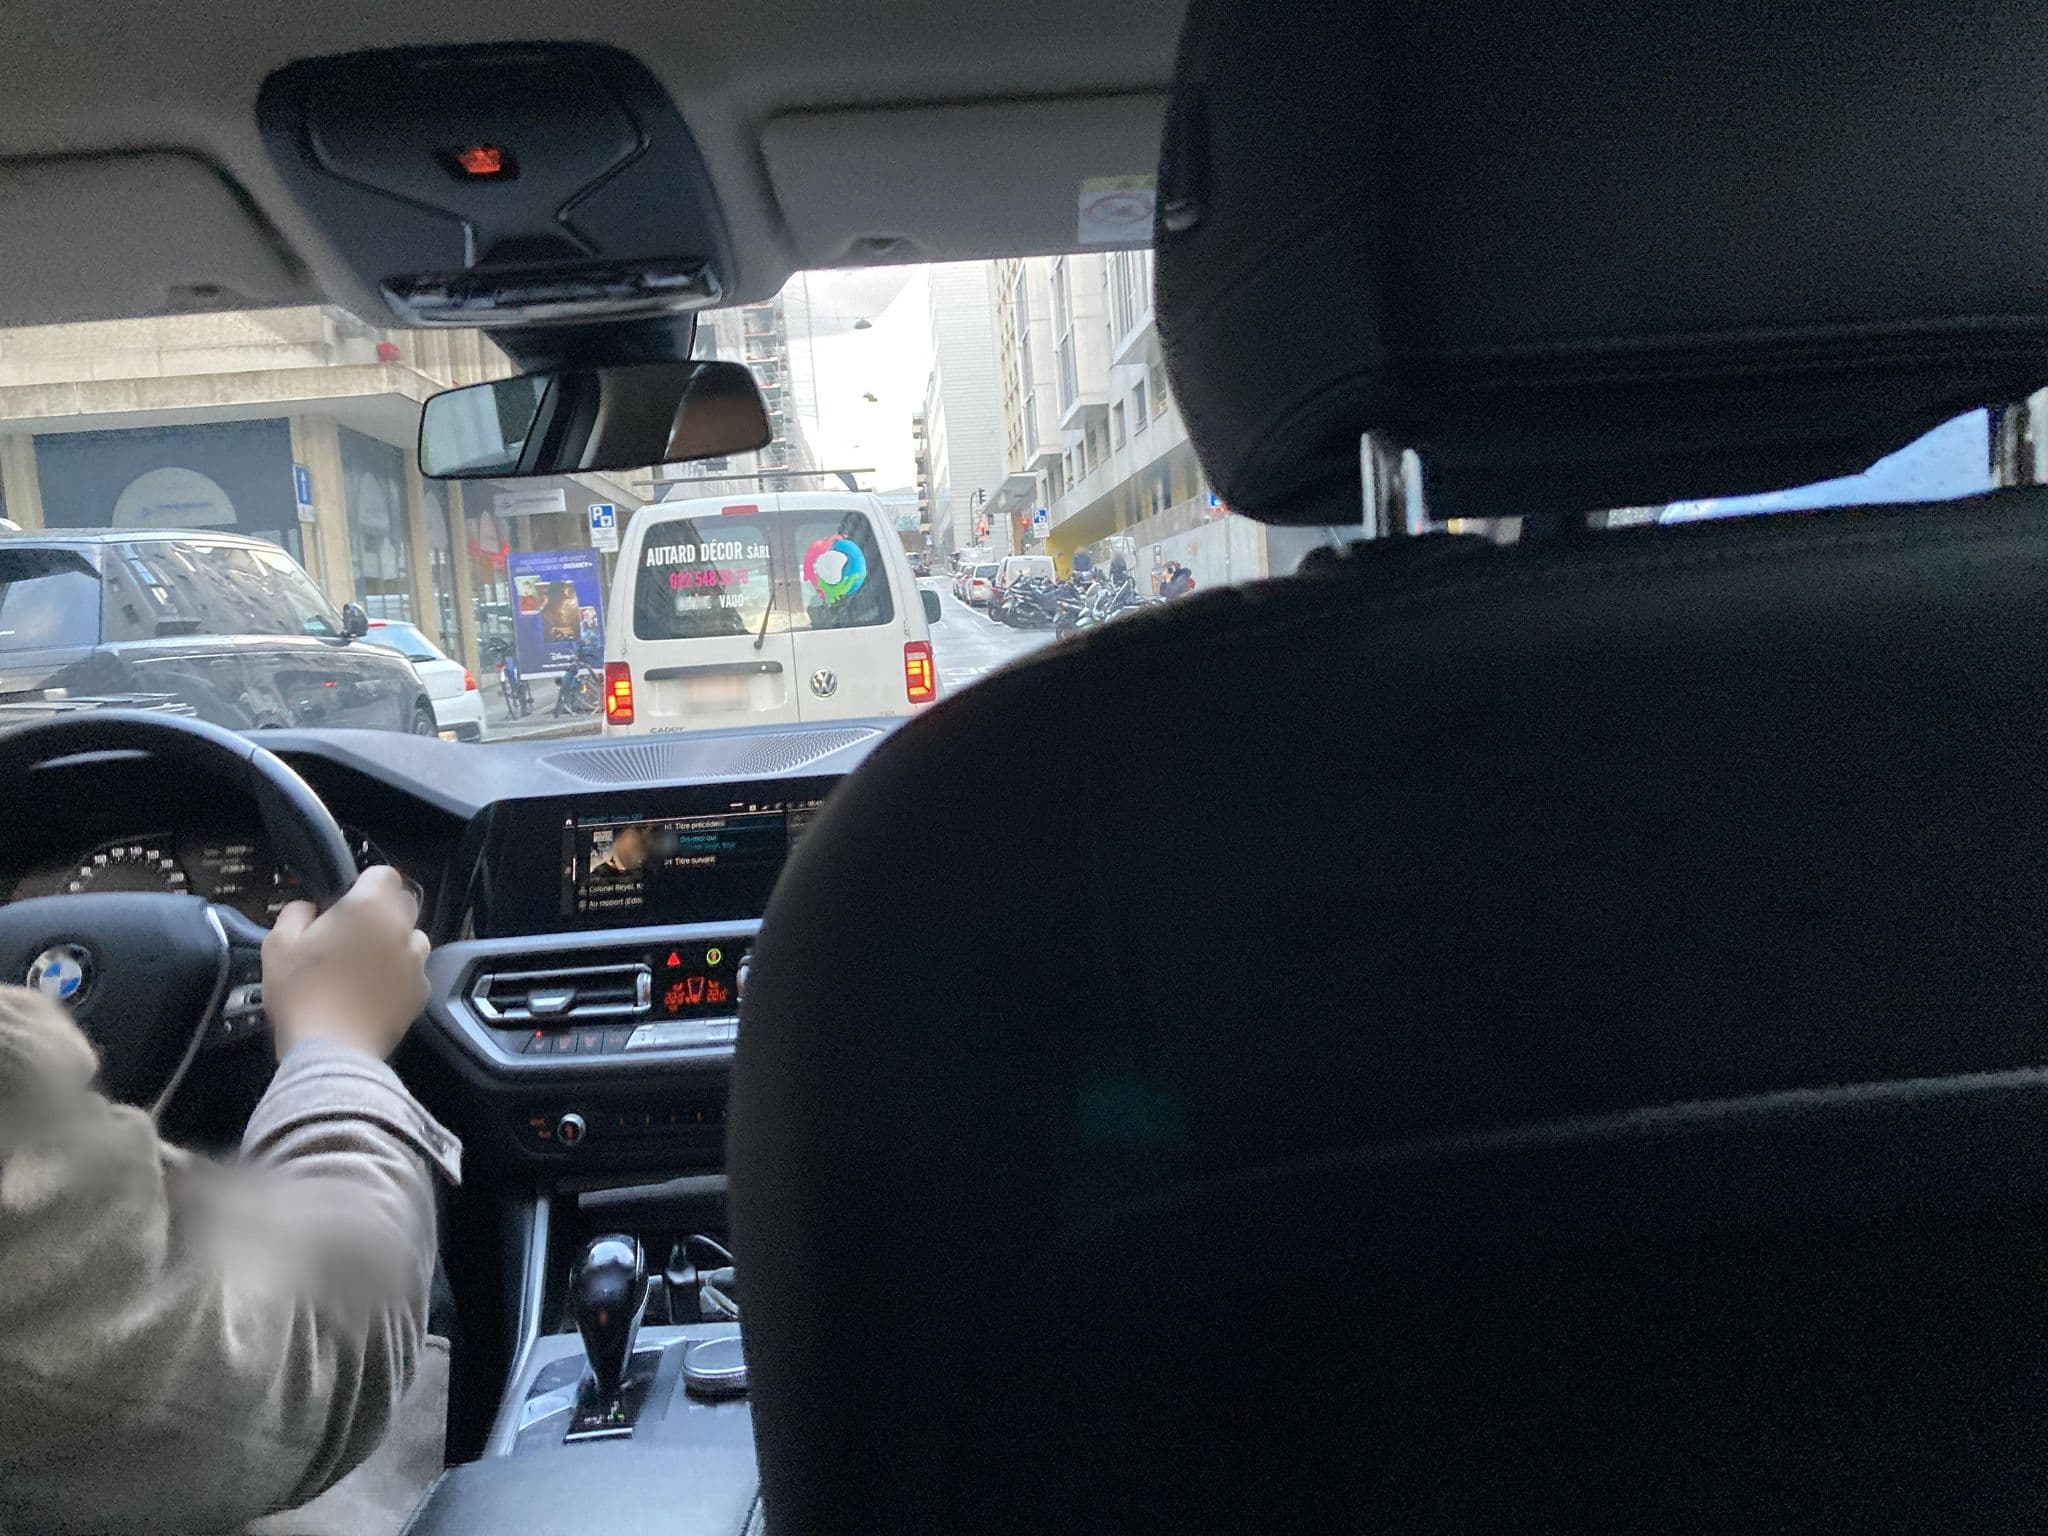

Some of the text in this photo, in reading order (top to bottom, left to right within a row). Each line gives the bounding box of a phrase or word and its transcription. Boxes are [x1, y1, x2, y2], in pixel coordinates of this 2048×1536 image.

[646, 544, 696, 567] AUTARD
[700, 539, 743, 562] DÉCOR
[112, 848, 124, 858] 120
[147, 850, 159, 860] 160
[94, 854, 107, 865] 100
